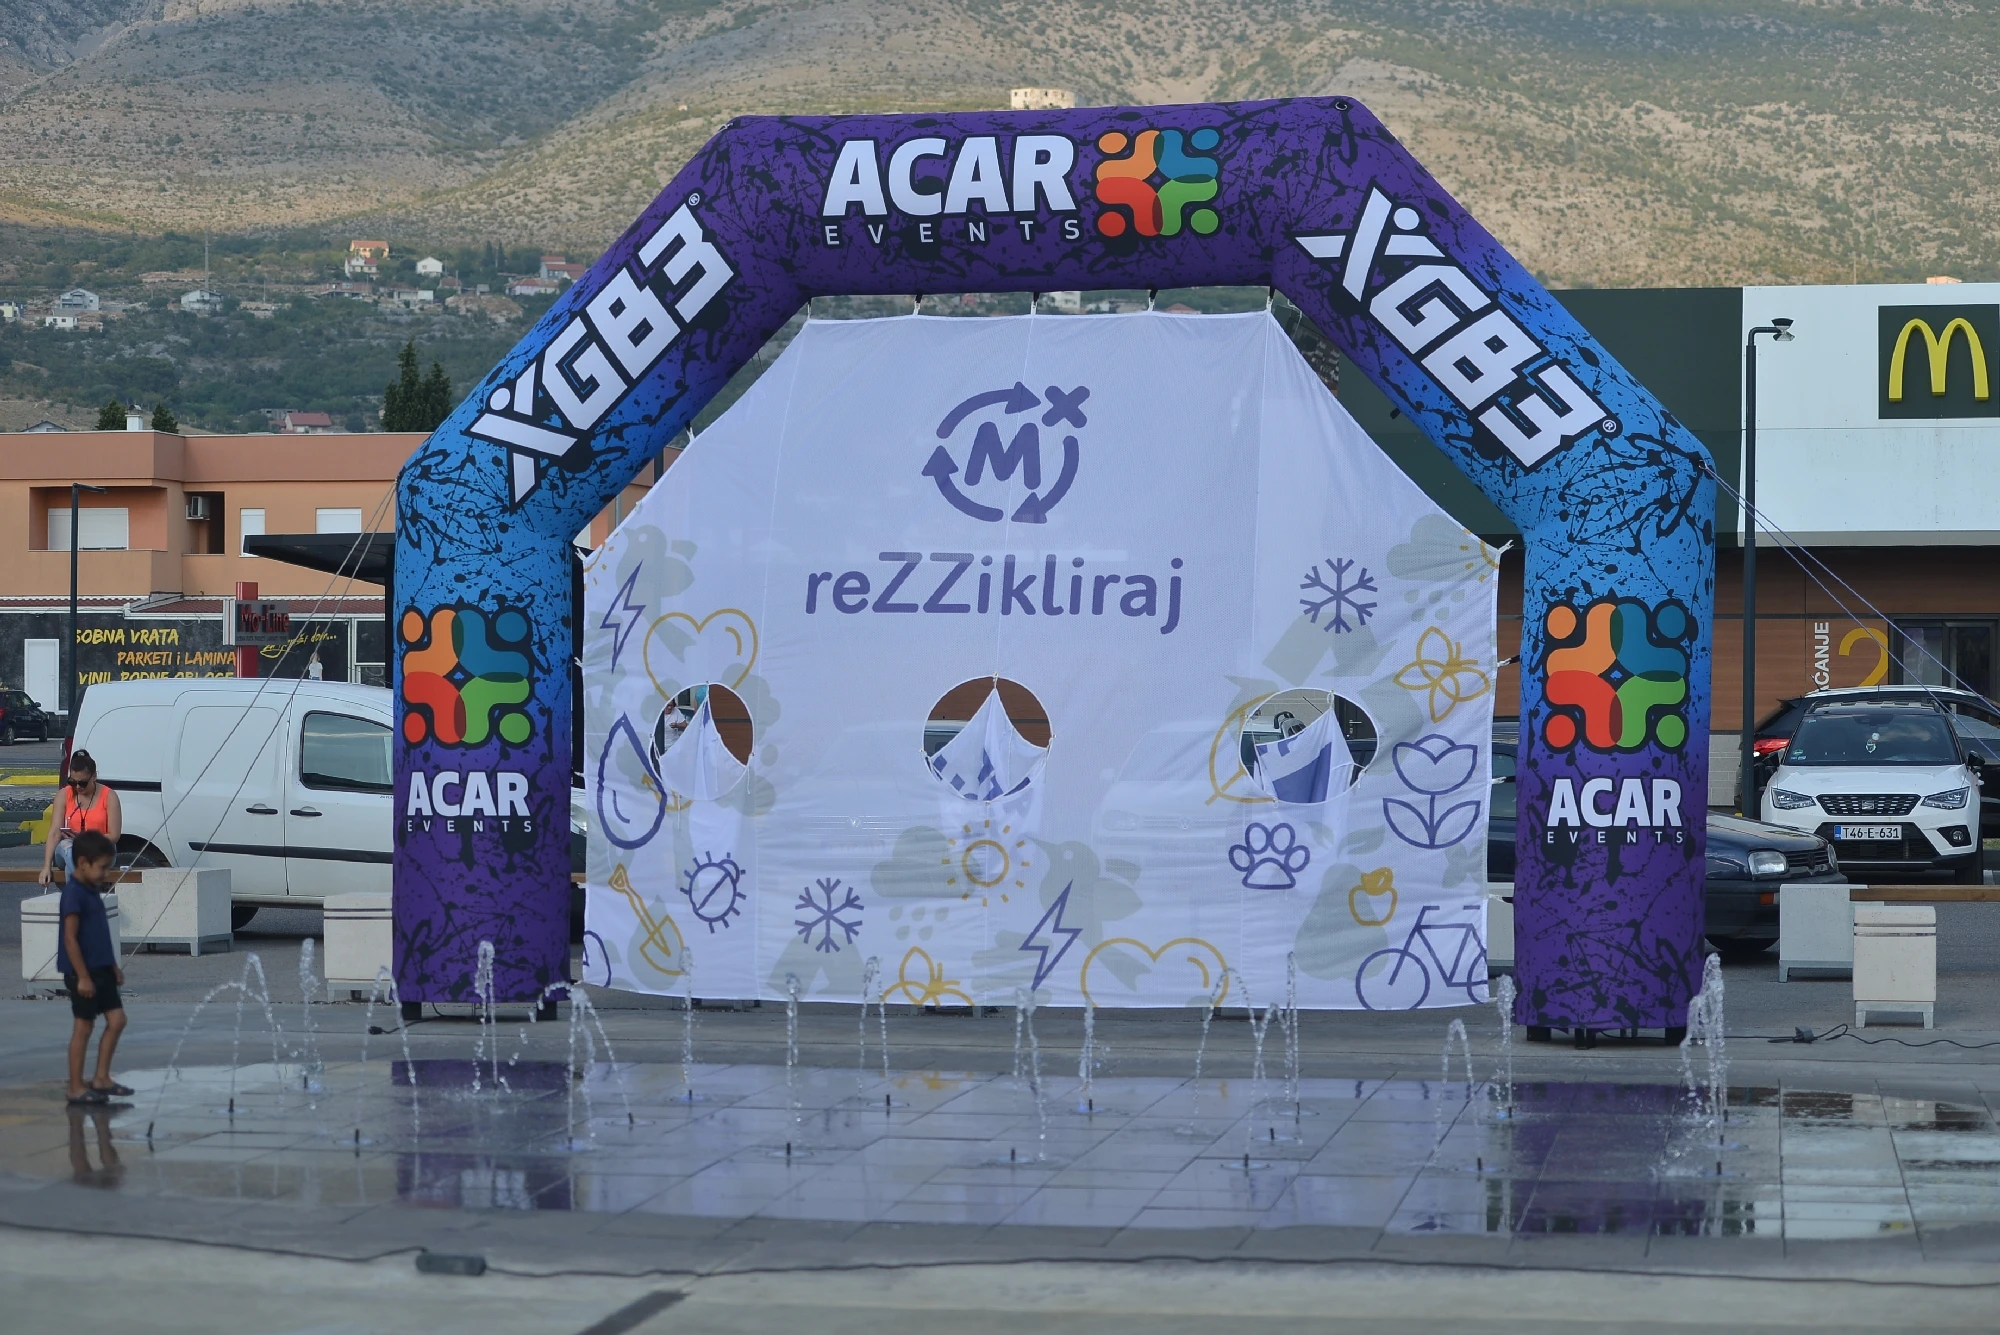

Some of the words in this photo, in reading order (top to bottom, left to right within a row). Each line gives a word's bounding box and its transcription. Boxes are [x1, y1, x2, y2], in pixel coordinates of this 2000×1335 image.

[823, 135, 1077, 217] ACAR
[825, 219, 1080, 245] EVENTS
[806, 551, 1183, 635] reZZikliraj
[131, 629, 179, 645] VRATA
[118, 651, 172, 666] PARKETI
[1839, 627, 1889, 687] 2
[407, 771, 531, 817] ACAR
[1547, 777, 1682, 827] ACAR
[407, 820, 532, 832] EVENTS
[1547, 831, 1683, 843] EVENTS
[1843, 827, 1899, 838] T46-E-631
